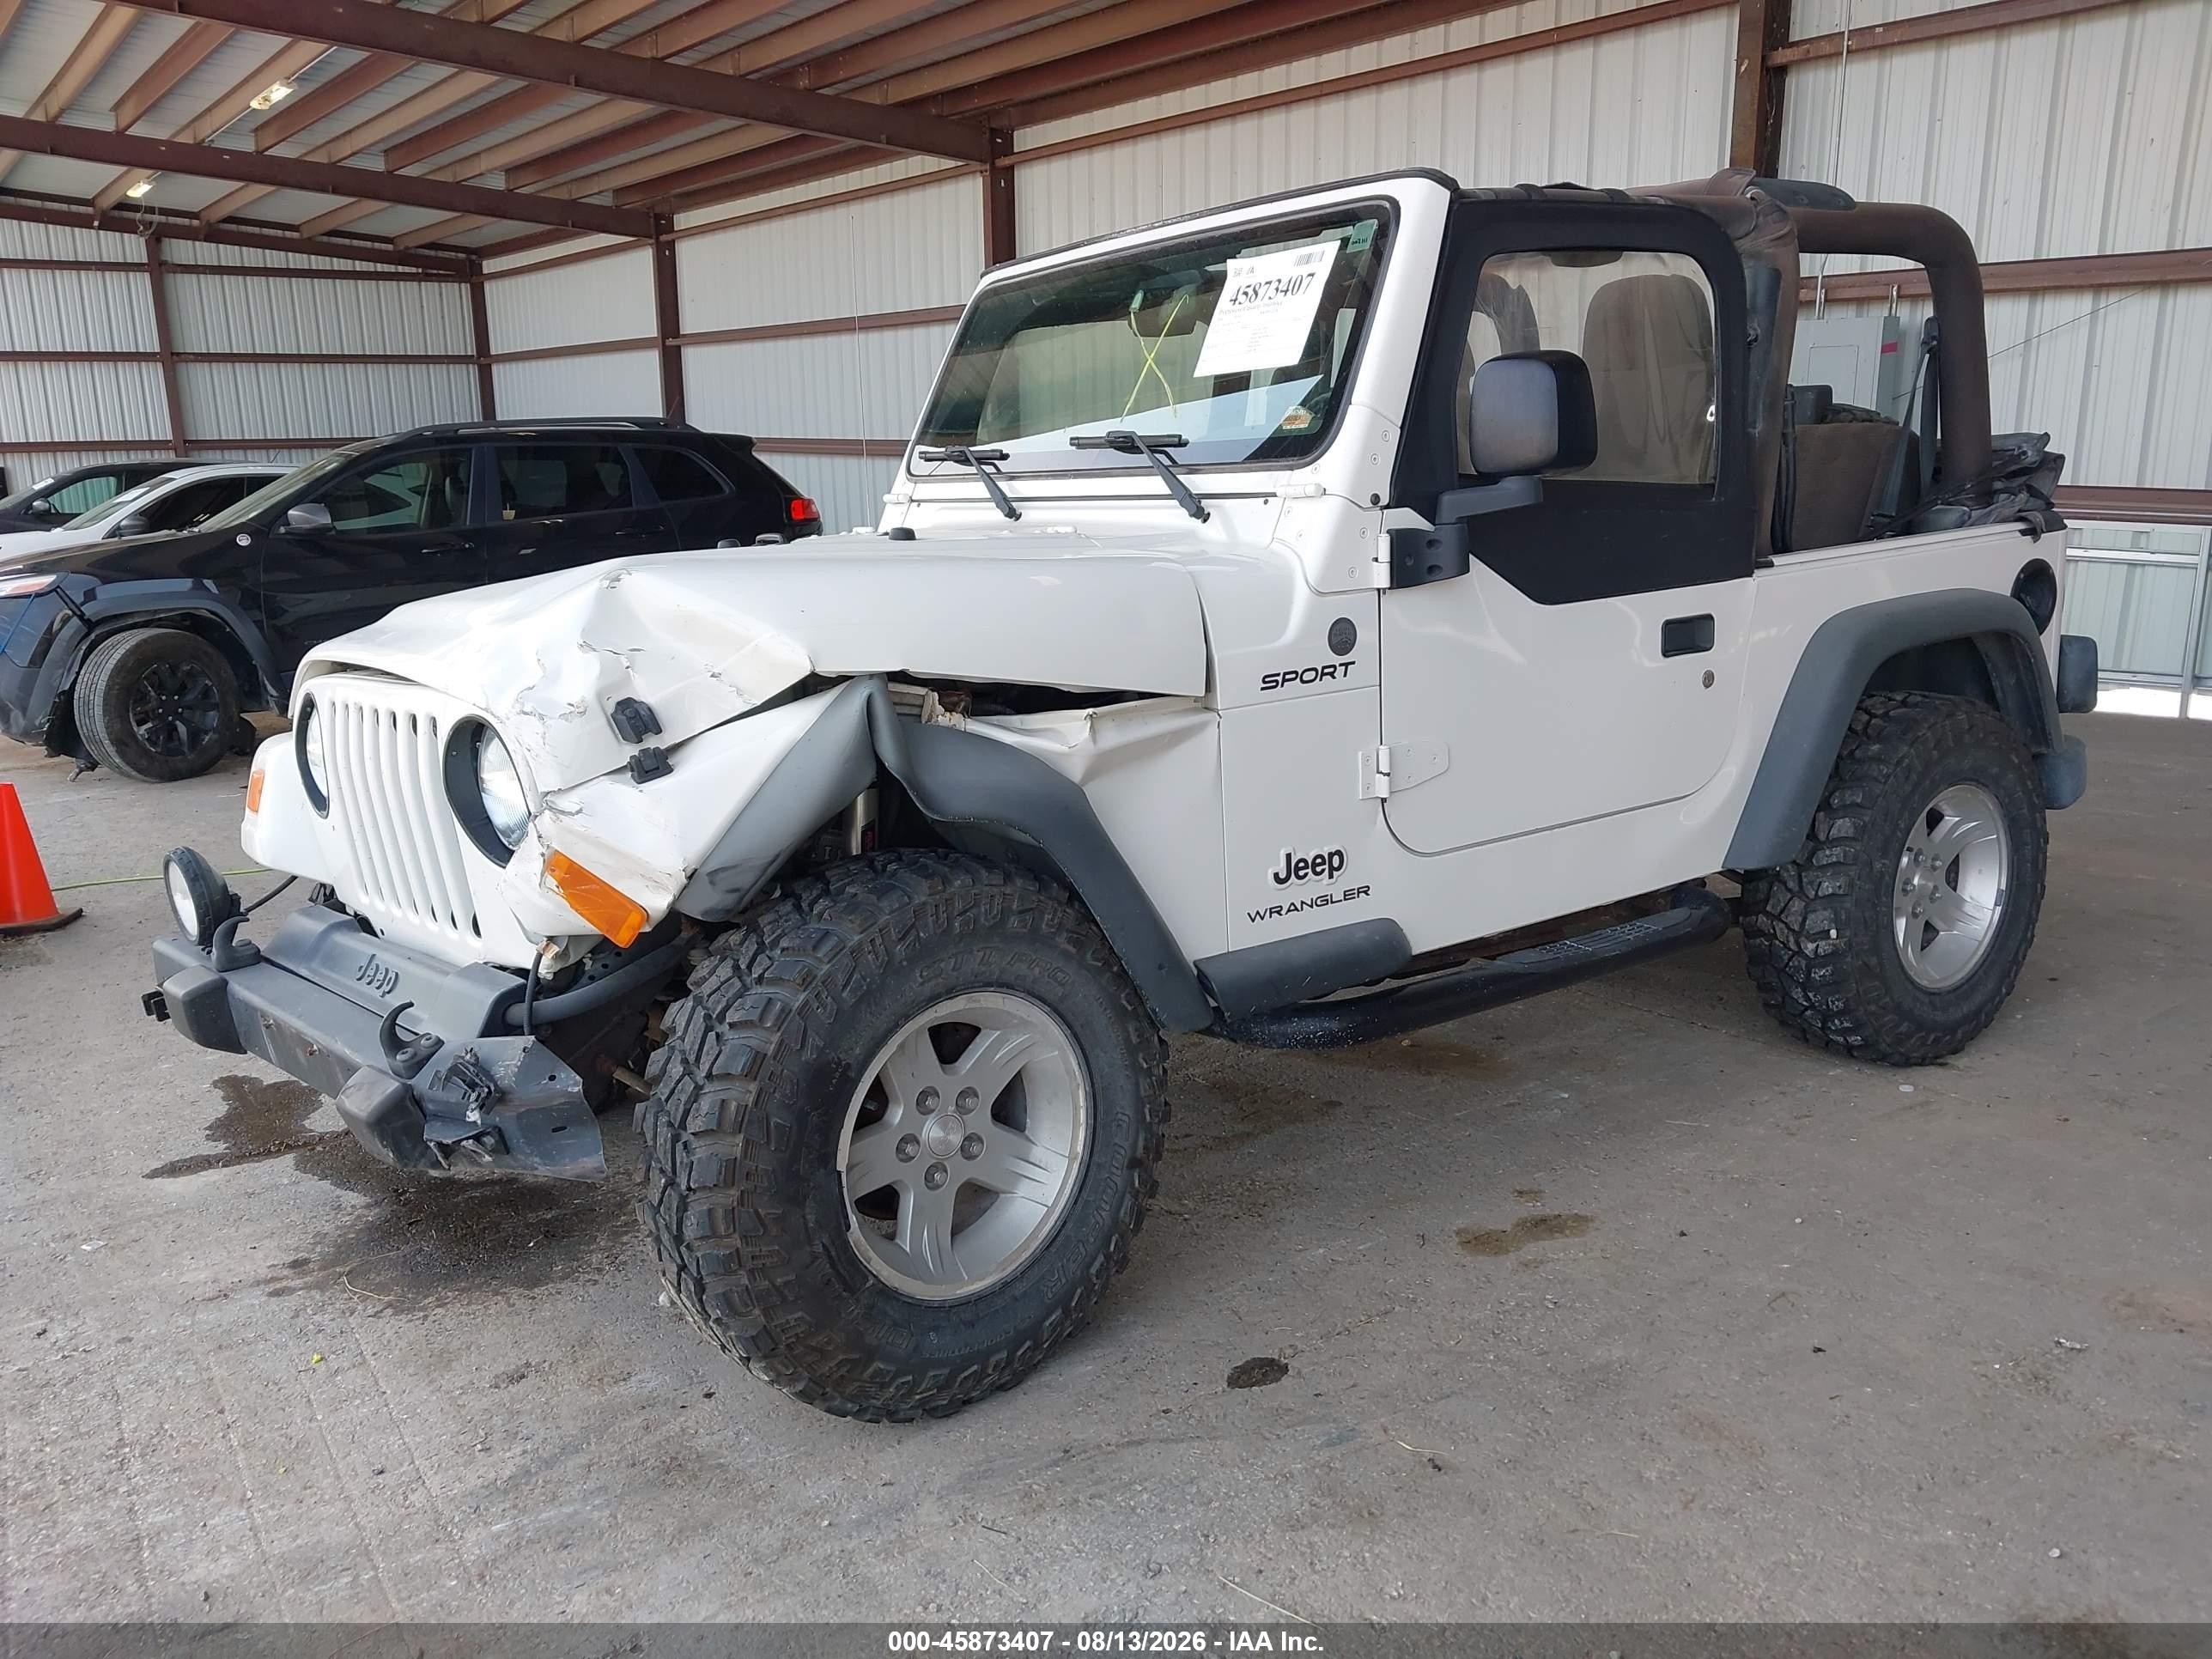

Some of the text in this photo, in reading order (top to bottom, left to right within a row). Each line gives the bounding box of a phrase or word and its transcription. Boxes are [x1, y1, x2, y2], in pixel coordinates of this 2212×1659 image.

[1229, 271, 1316, 307] 45873407
[1260, 660, 1356, 691] SPORT
[1273, 848, 1345, 885] Jeep
[1247, 885, 1371, 923] WRANGLER
[355, 953, 399, 999] Jeep
